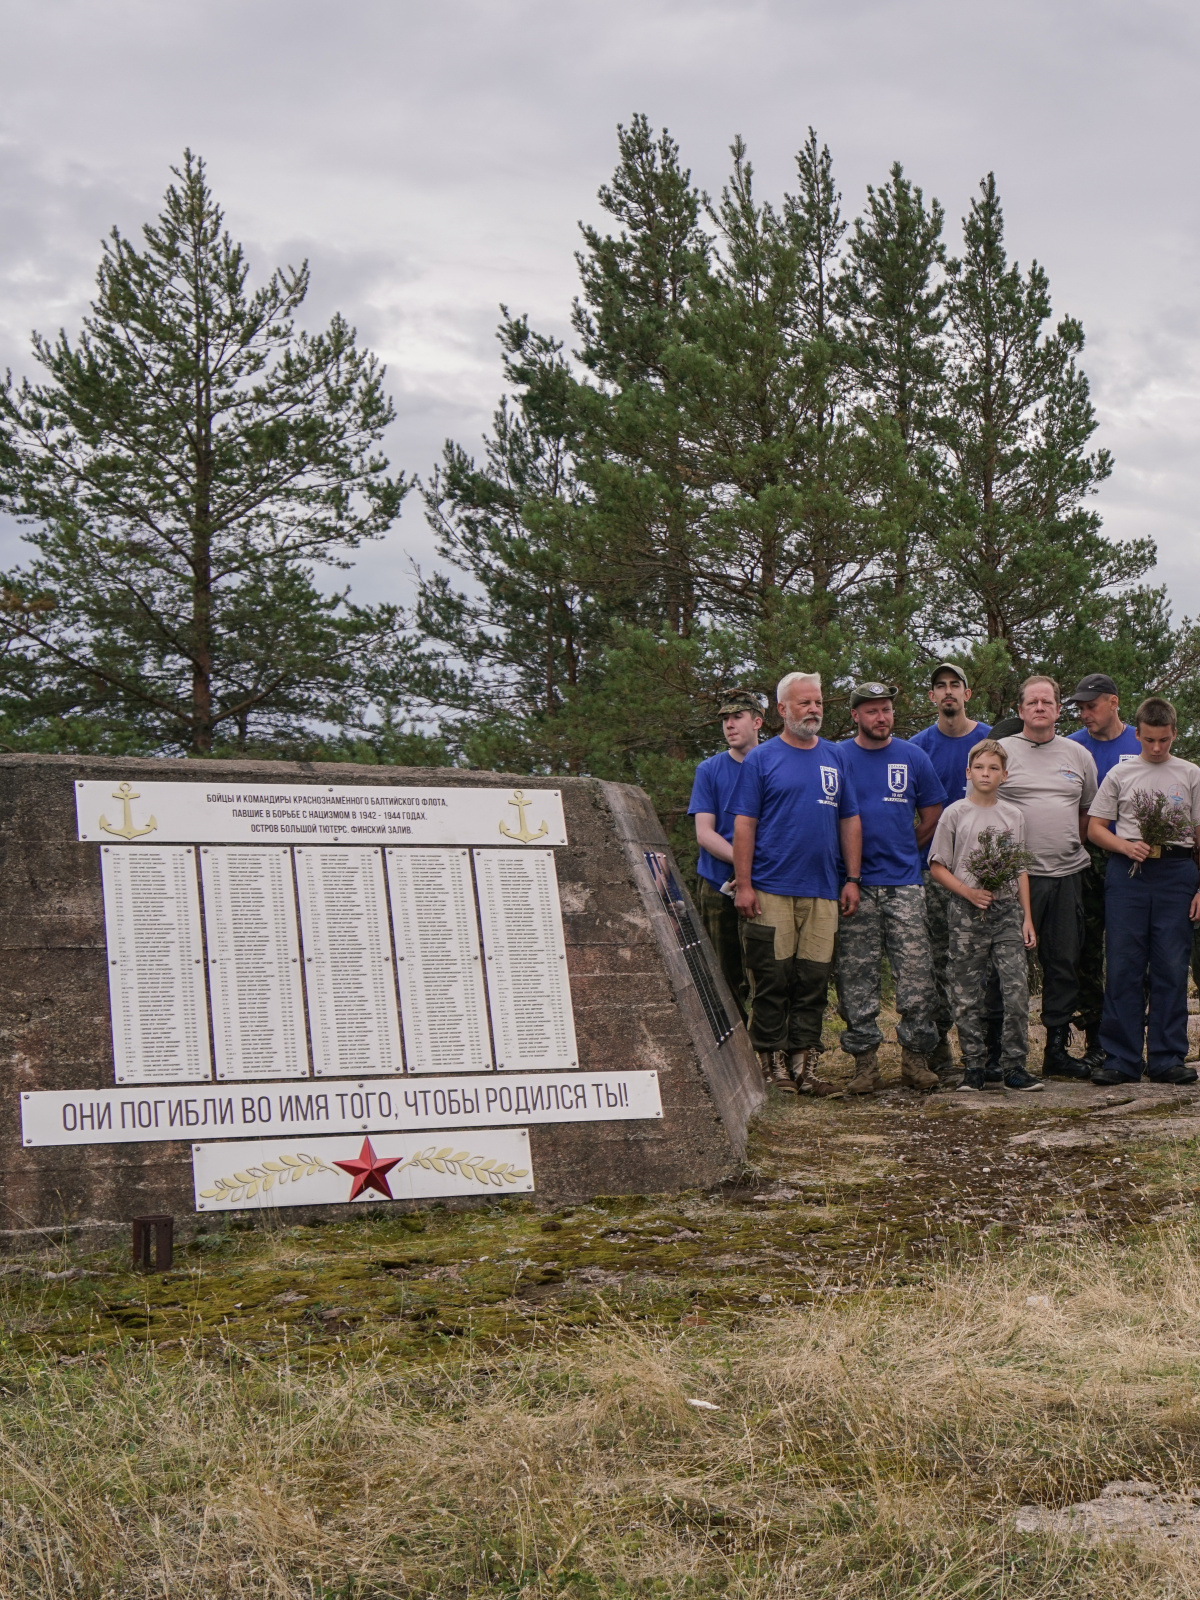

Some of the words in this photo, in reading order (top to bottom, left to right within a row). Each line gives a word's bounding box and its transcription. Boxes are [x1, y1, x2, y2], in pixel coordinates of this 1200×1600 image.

[206, 793, 234, 803] БОЙЦЫ
[236, 794, 242, 803] И
[243, 795, 291, 804] КОМАНДИРЫ
[293, 796, 369, 805] КРАСНОЗНАМЁННОГО
[371, 796, 420, 806] БАЛТИЙСКОГО
[421, 798, 448, 807] ФЛОТА,
[232, 809, 264, 818] ПАВШИЕ
[266, 810, 271, 818] В
[272, 810, 301, 818] БОРЬБЕ
[302, 810, 307, 818] С
[309, 810, 350, 819] НАЦИЗМОМ
[402, 812, 428, 820] ГОДАХ.
[251, 824, 279, 833] ОСТРОВ
[281, 824, 317, 833] БОЛЬШОЙ
[318, 825, 349, 834] ТЮТЕРС.
[351, 825, 386, 834] ФИНСКИЙ
[388, 826, 414, 834] ЗАЛИВ.
[62, 1102, 112, 1132] ОНИ
[120, 1098, 234, 1128] ПОГИБЛИ
[242, 1096, 272, 1124] ВО
[279, 1094, 330, 1122] ИМЯ
[335, 1092, 398, 1120] ТОГО,
[404, 1088, 480, 1116] ЧТОБЫ
[486, 1083, 587, 1114] РОДИЛСЯ
[592, 1082, 629, 1108] ТЫ!
